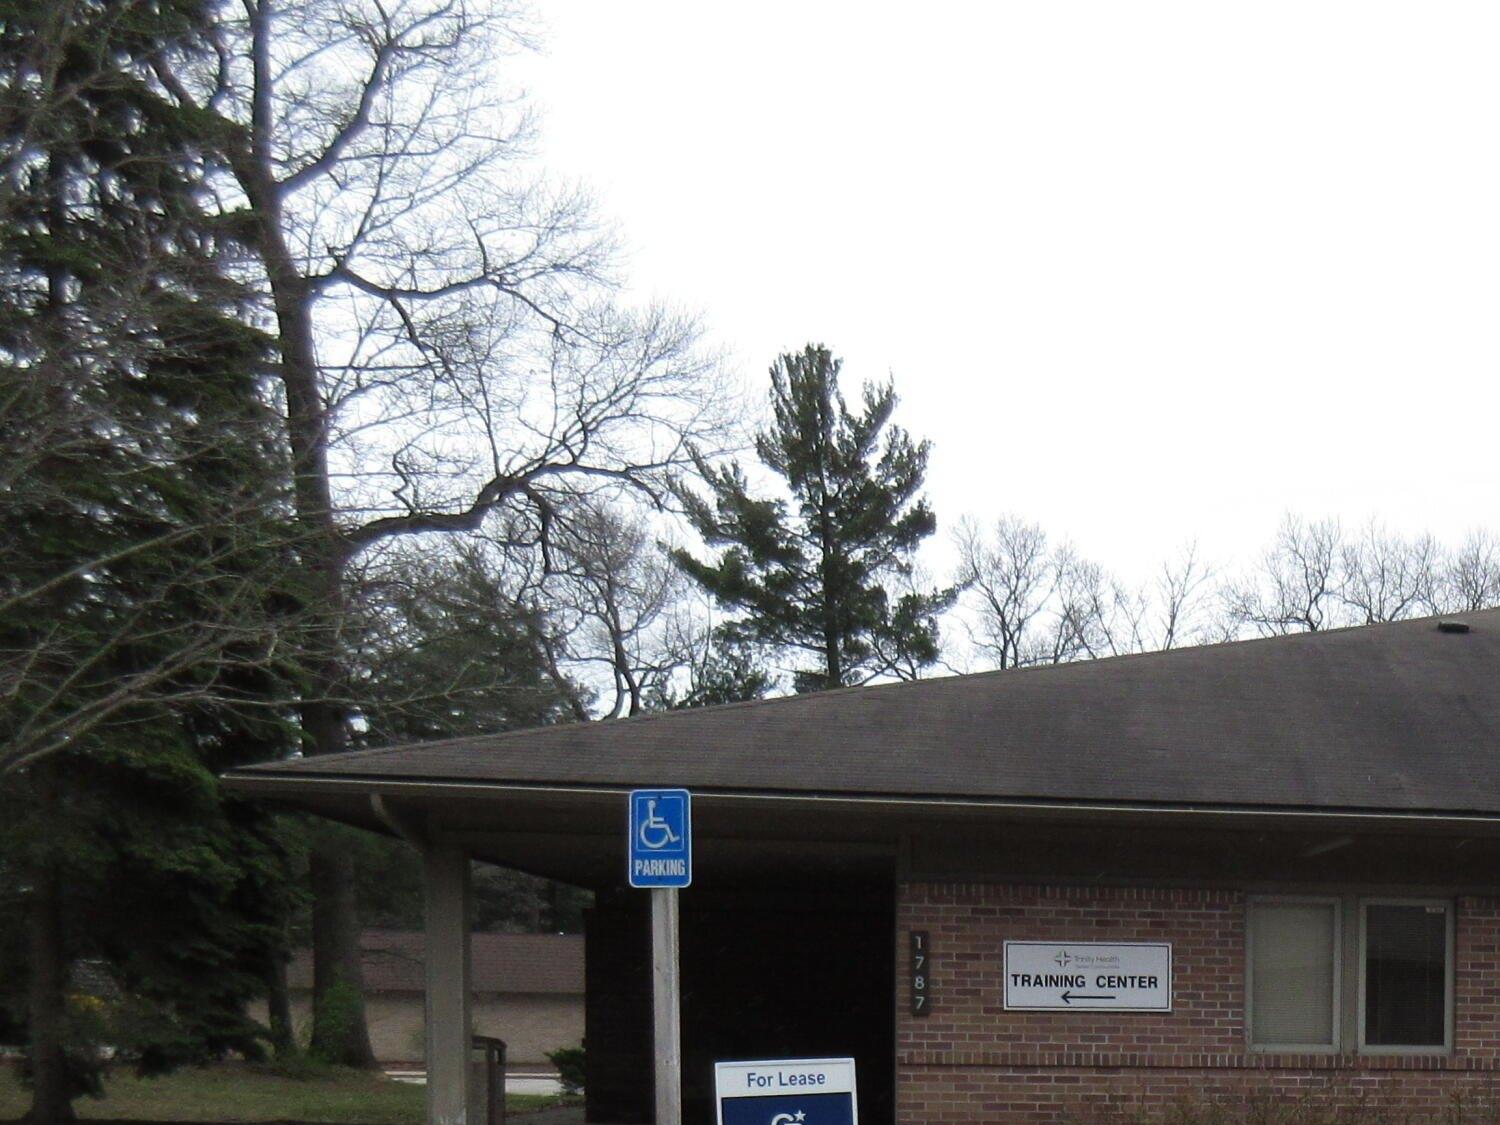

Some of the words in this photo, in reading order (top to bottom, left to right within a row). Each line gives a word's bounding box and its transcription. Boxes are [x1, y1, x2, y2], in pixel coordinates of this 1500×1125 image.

[635, 859, 686, 876] PARKING
[914, 935, 925, 1010] 1787
[1011, 973, 1086, 988] TRAINING
[1096, 975, 1158, 989] CENTER
[747, 1073, 773, 1087] For
[779, 1072, 825, 1086] Lease
